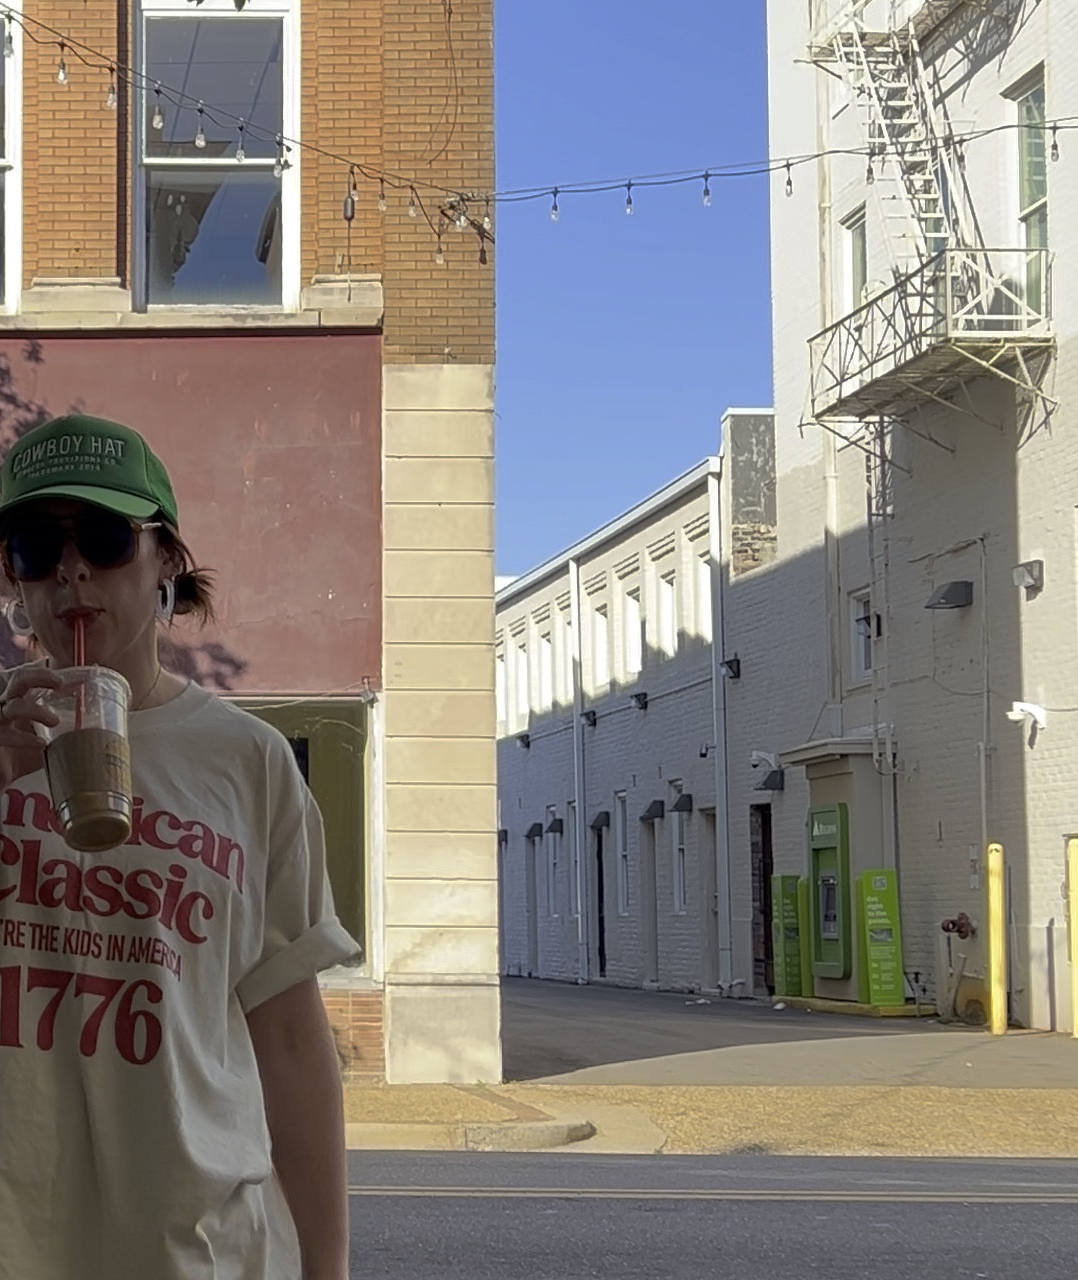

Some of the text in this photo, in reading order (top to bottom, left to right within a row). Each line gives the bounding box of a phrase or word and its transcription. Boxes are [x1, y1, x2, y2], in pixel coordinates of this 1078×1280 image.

[13, 435, 83, 473] COWBOY
[91, 436, 125, 457] HAT
[29, 922, 60, 953] THE
[62, 926, 103, 959] KIDS
[106, 933, 126, 962] IN
